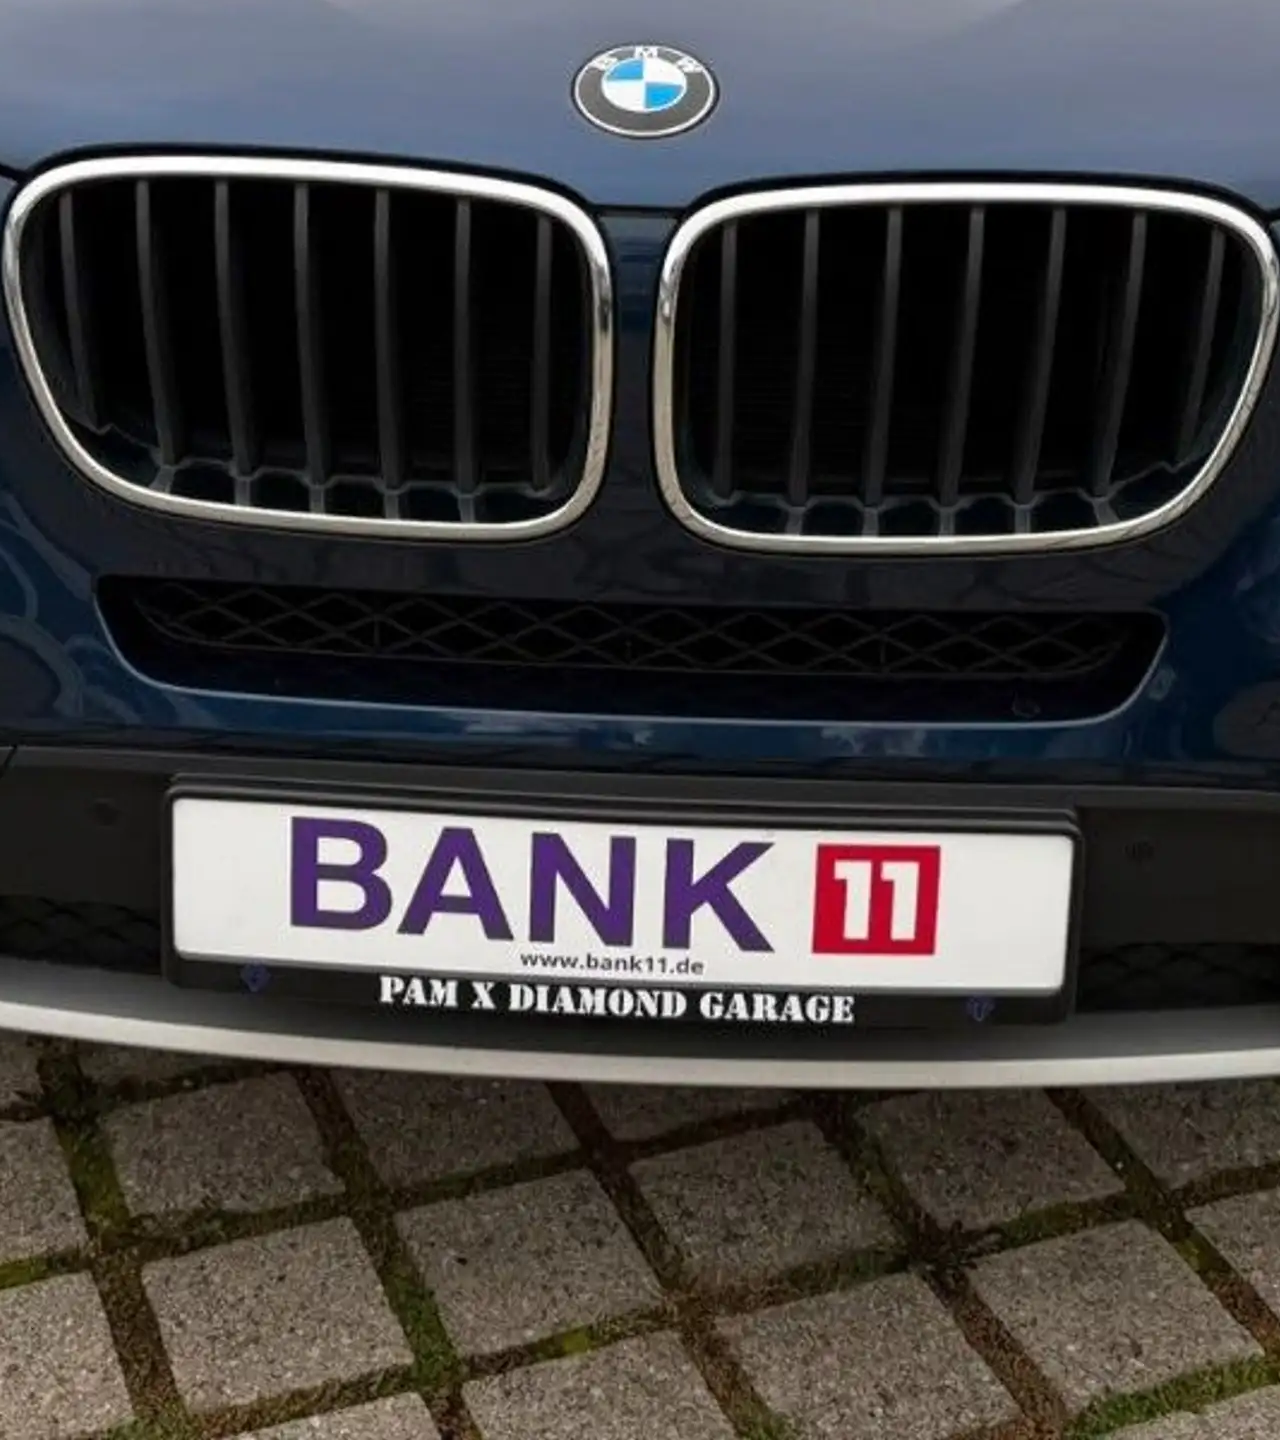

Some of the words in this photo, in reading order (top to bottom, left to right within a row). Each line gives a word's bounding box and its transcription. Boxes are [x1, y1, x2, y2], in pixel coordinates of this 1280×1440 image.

[290, 816, 775, 953] BANK
[833, 859, 920, 942] 11
[520, 953, 705, 976] www.bank11.de
[379, 975, 458, 1007] PAM
[471, 981, 495, 1009] X
[509, 984, 687, 1018] DIAMOND
[699, 991, 855, 1023] GARAGE
